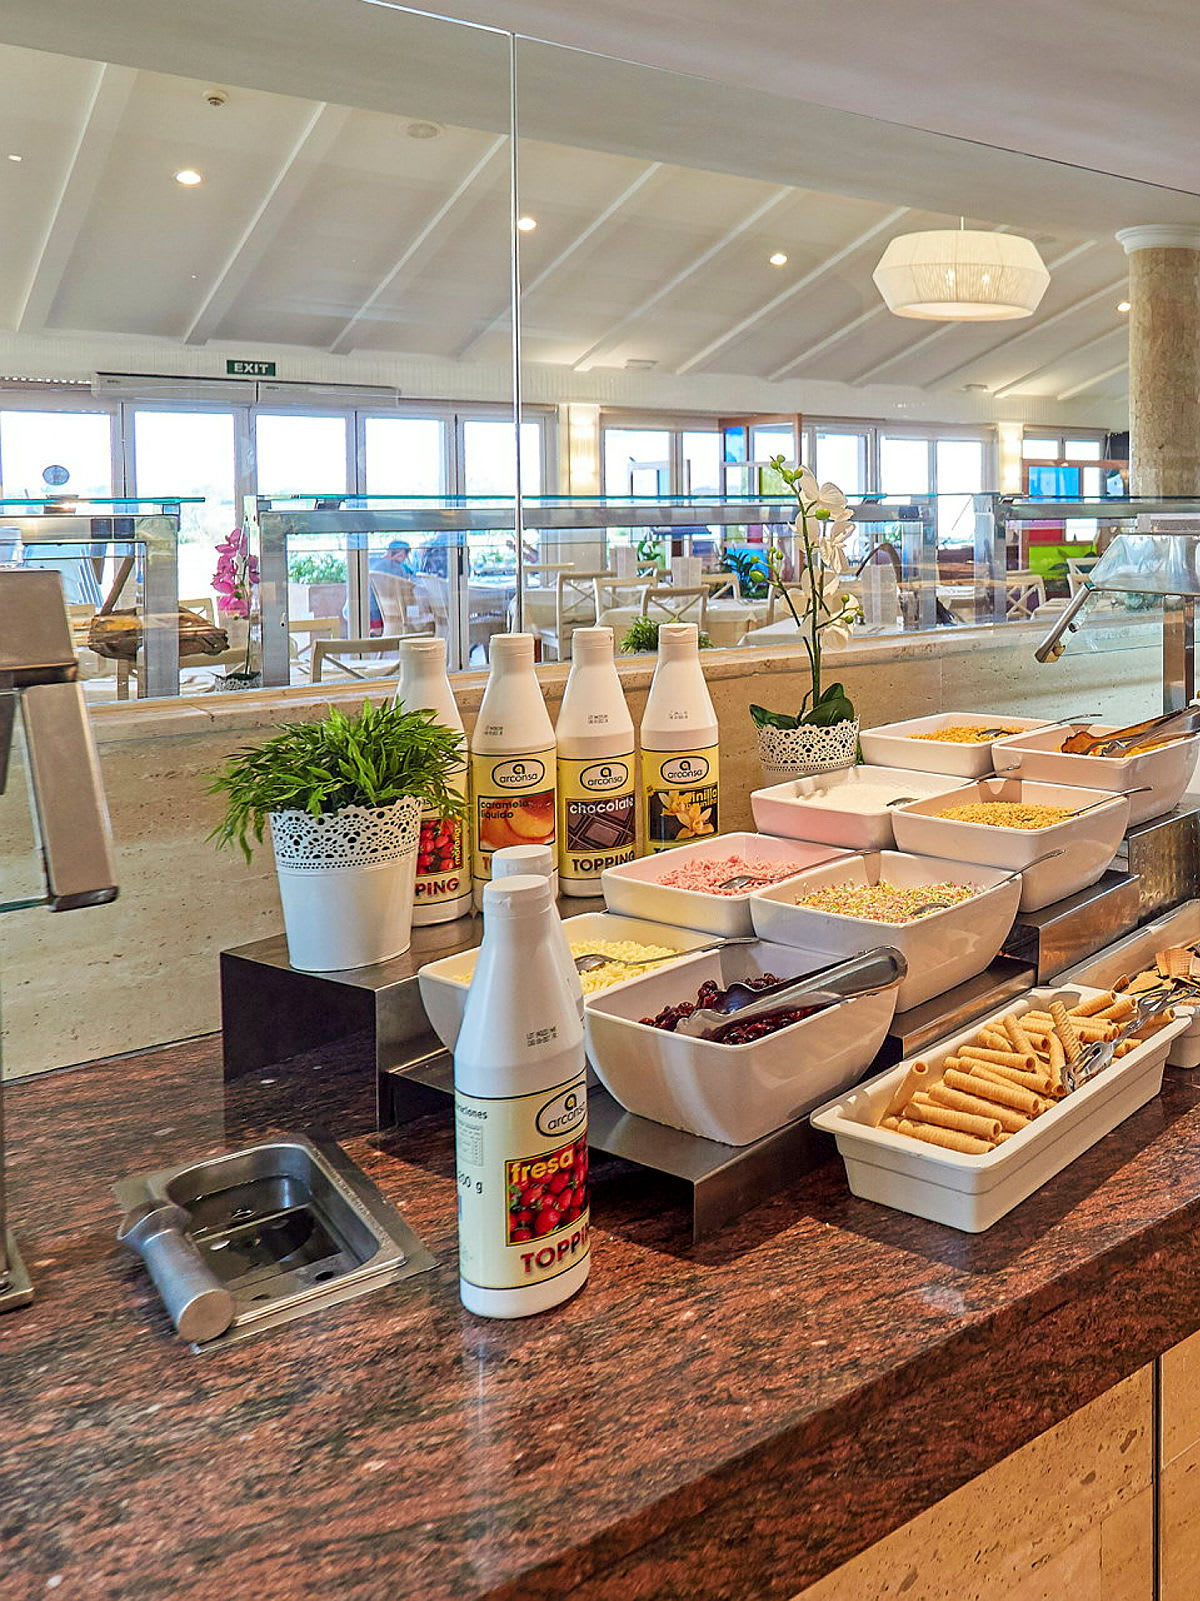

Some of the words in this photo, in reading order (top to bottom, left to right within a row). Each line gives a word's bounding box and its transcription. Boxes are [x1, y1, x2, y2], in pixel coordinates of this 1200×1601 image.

[233, 362, 269, 375] EXIT
[499, 772, 538, 784] arconsa
[587, 775, 623, 786] arconsa
[667, 769, 703, 779] arconsa
[415, 877, 460, 897] PING
[511, 1149, 574, 1185] fresa
[521, 1223, 589, 1273] TOPPI
